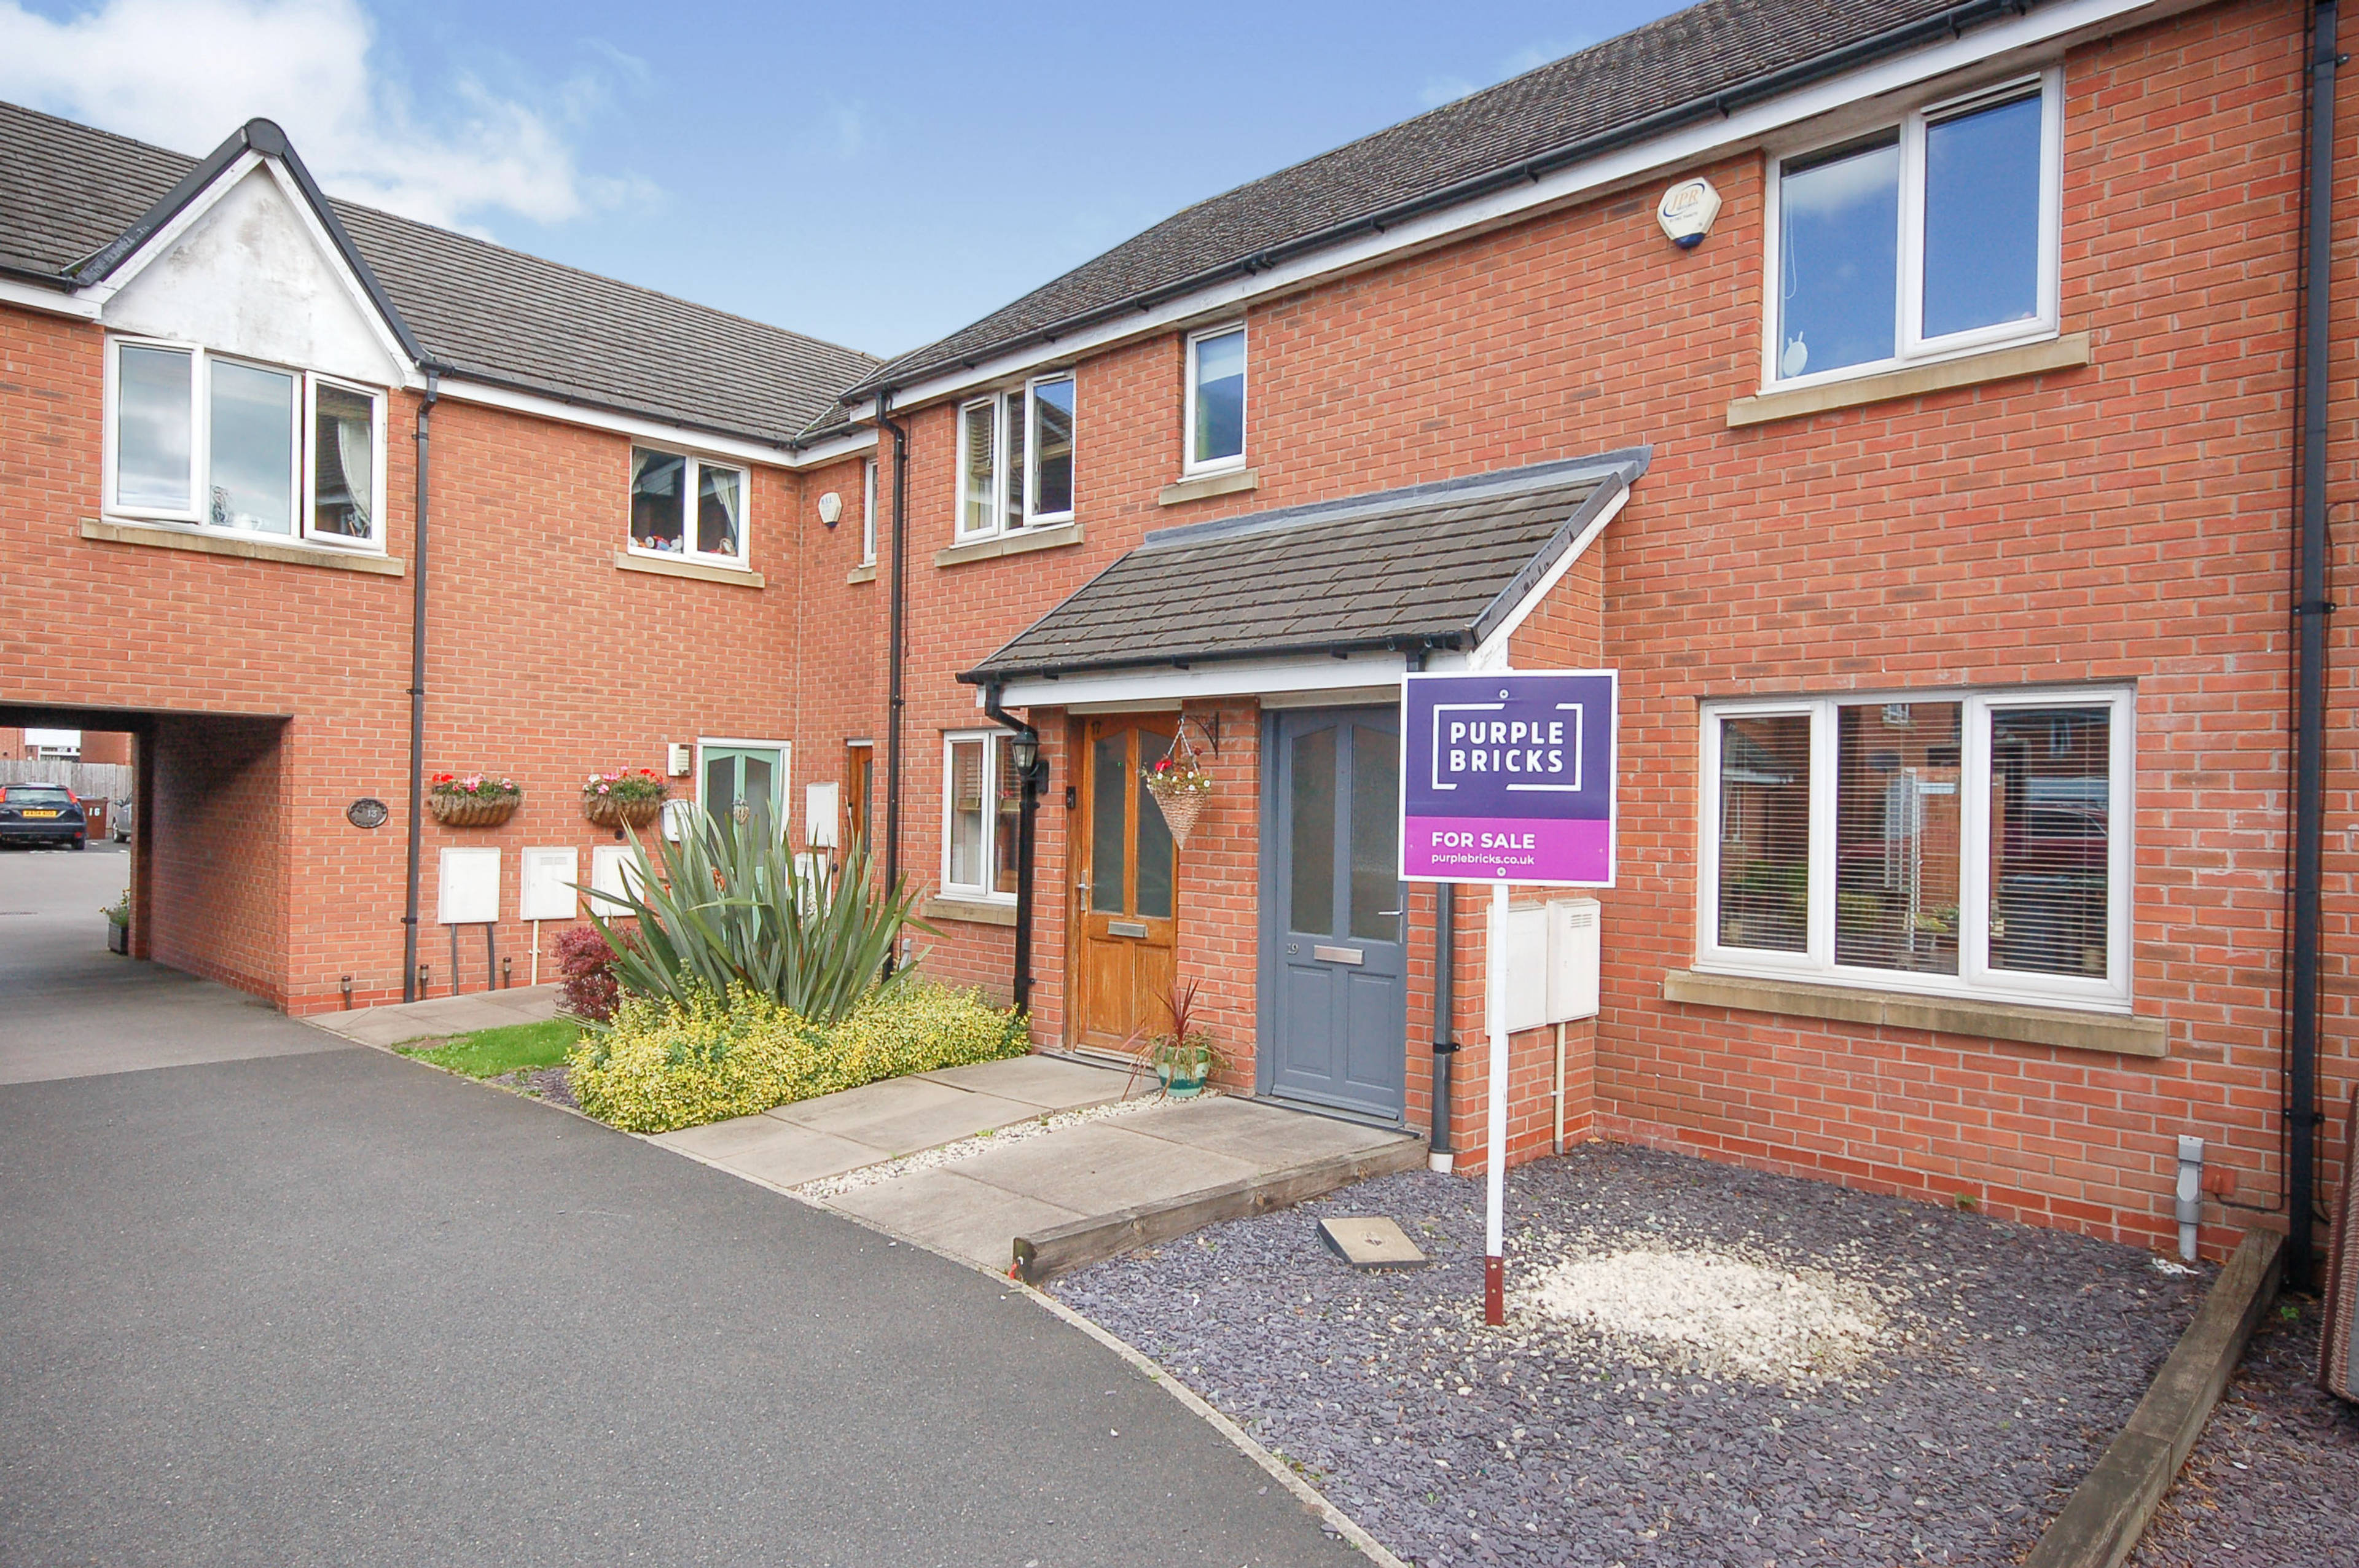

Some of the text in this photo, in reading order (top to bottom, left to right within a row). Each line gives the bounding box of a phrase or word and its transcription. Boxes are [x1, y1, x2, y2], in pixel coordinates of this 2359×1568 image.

[1450, 721, 1563, 744] PURPLE
[1450, 749, 1563, 773] BRICKS
[367, 809, 377, 818] 13
[1431, 832, 1535, 849] FOR SALE
[1431, 853, 1535, 865] purplebricks.co.uk
